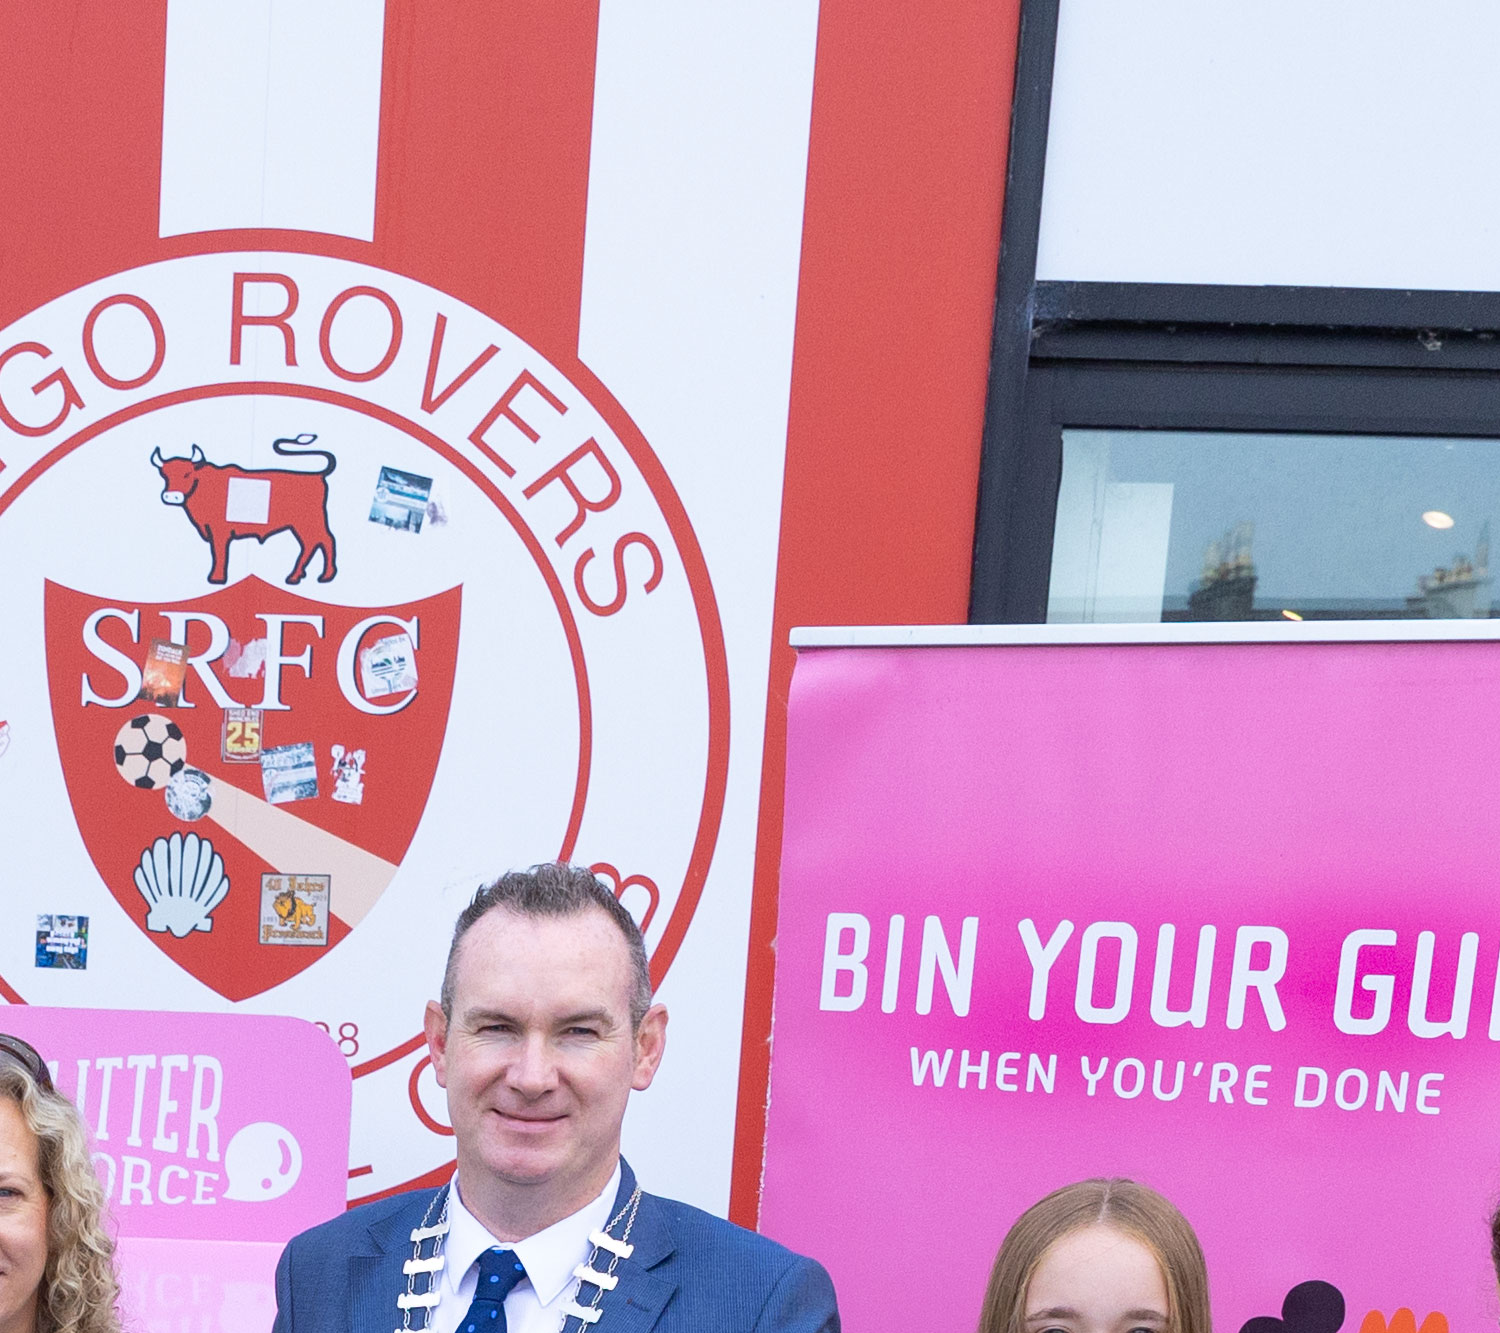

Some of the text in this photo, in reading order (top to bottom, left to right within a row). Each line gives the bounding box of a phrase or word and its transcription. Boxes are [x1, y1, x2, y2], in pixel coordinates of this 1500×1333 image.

[228, 272, 664, 619] ROVERS
[81, 607, 418, 715] SRFC
[819, 912, 979, 1016] BIN
[1017, 918, 1289, 1032] YOUR
[909, 1047, 1445, 1115] WHEN YOU'RE DONE
[91, 1151, 219, 1206] ORCE
